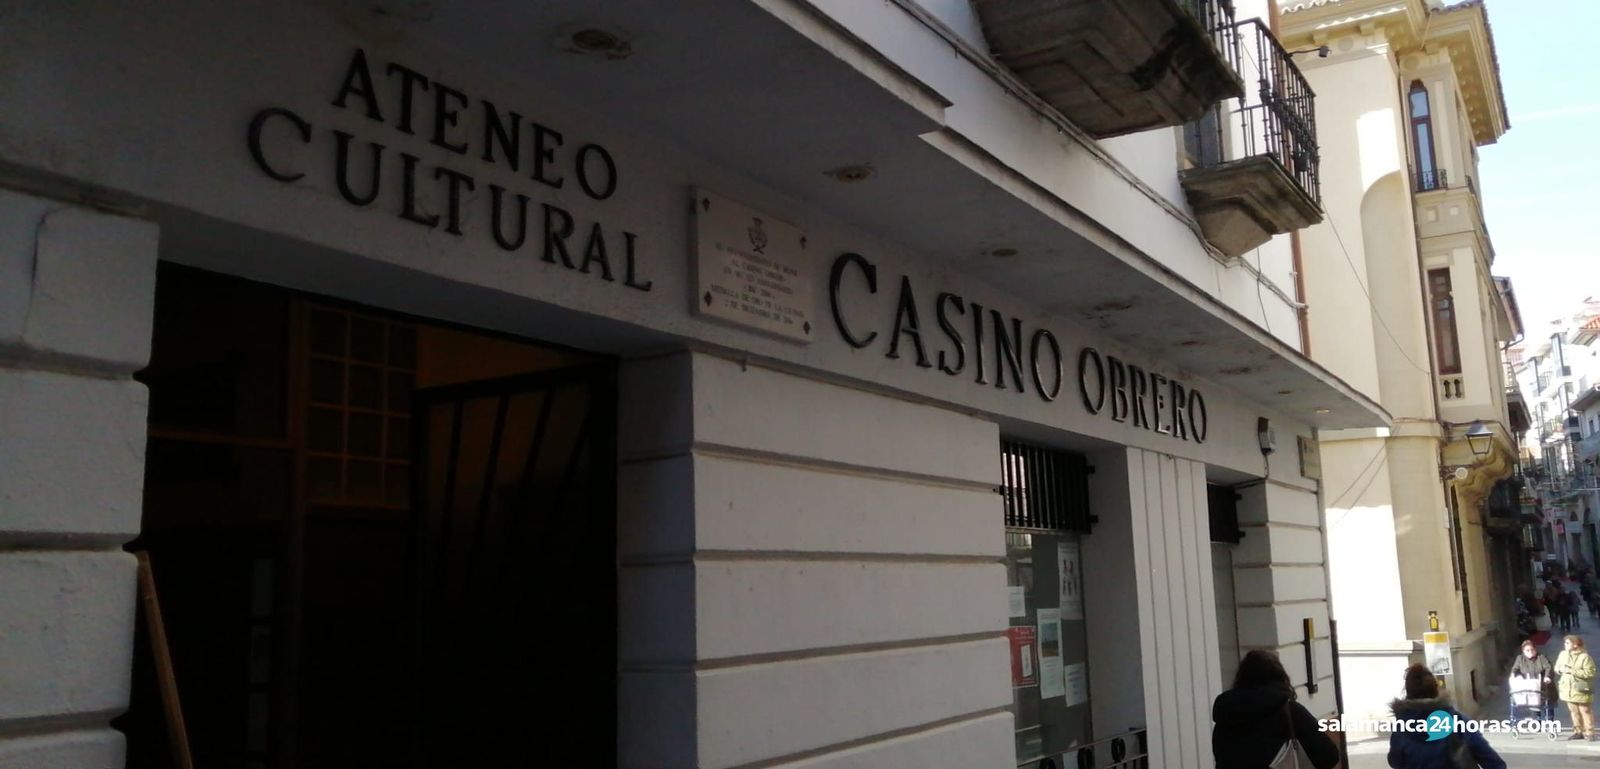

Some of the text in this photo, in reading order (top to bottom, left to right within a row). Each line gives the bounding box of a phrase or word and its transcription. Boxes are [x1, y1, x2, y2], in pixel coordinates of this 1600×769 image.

[247, 107, 652, 291] CULTURAL
[331, 47, 617, 200] ATENEO
[829, 252, 1207, 444] CASINO OBRERO
